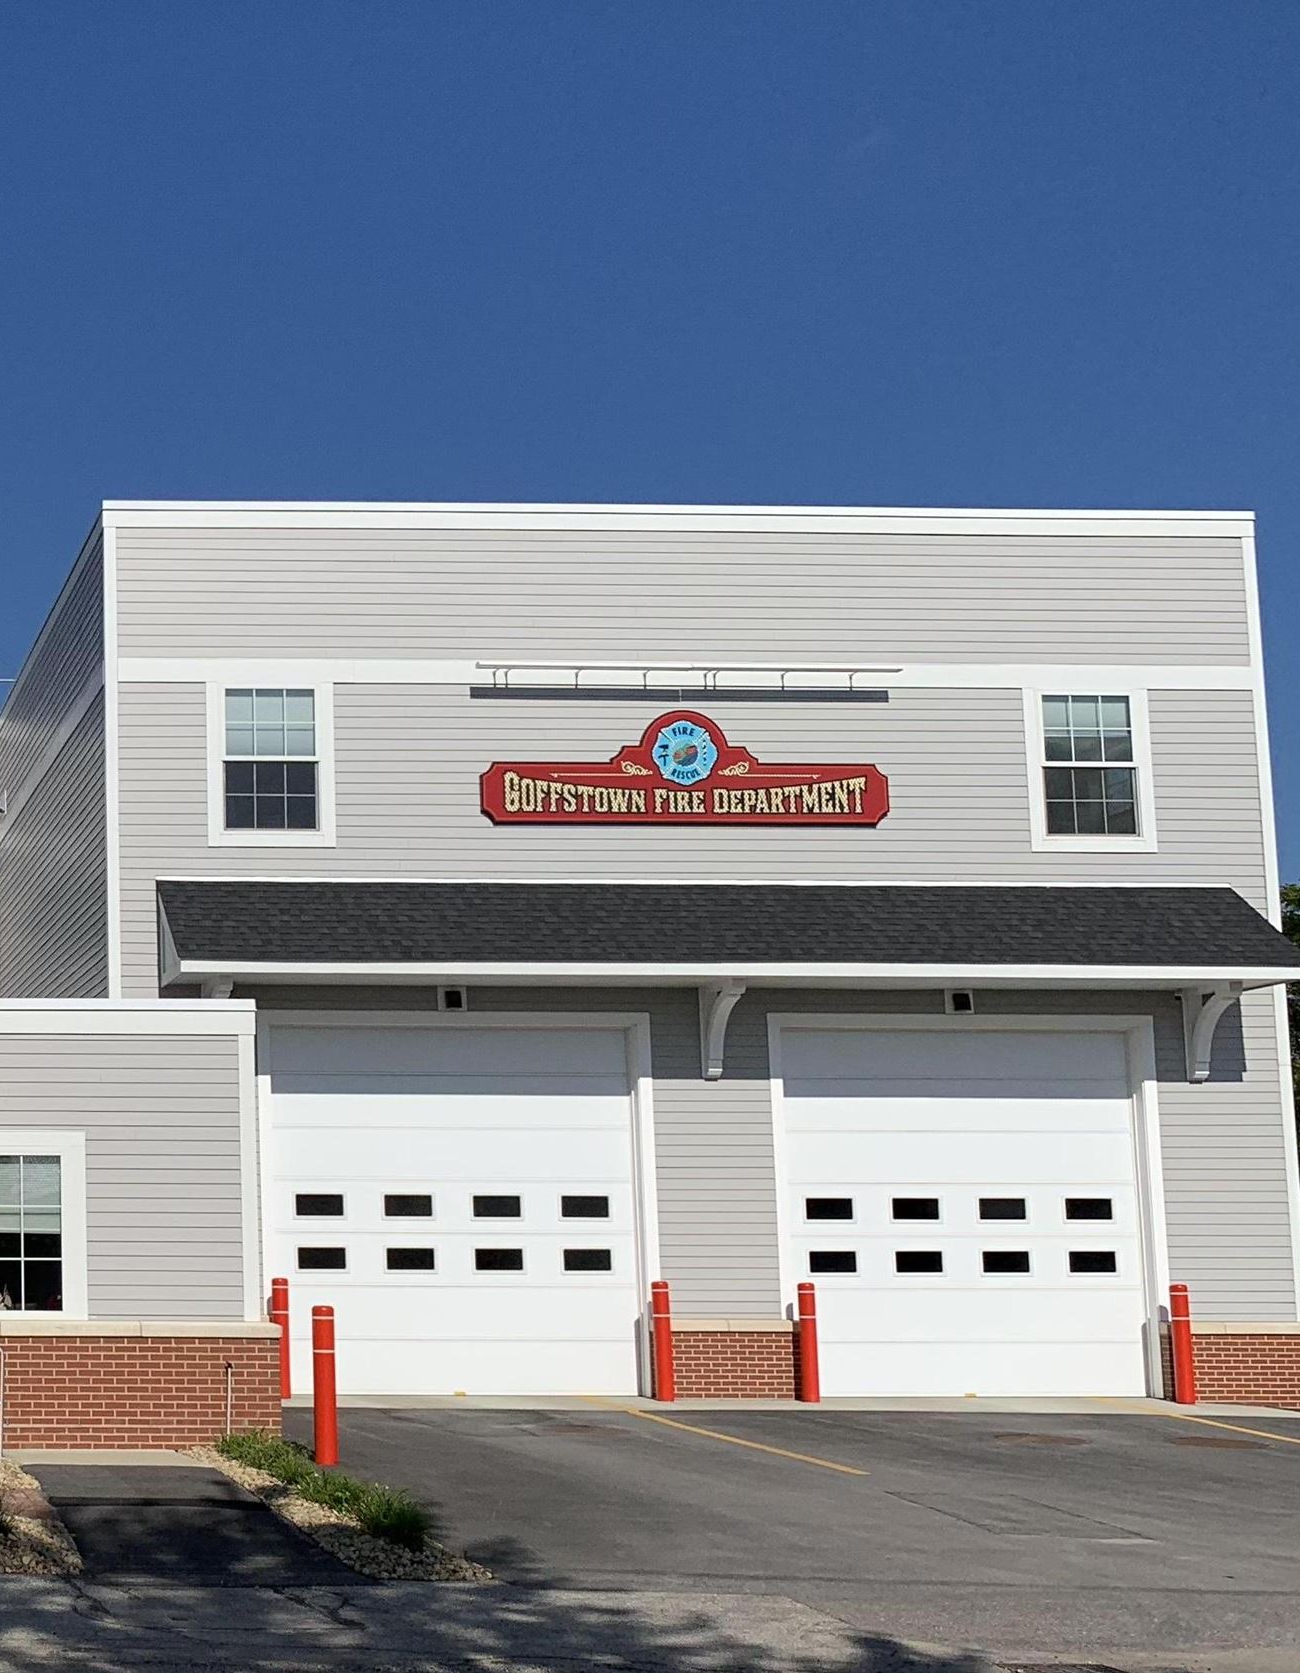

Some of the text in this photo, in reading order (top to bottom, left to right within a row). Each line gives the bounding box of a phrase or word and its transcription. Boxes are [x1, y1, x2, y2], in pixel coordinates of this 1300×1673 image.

[672, 726, 696, 737] FIRE
[671, 768, 700, 780] RESCUE
[503, 771, 866, 813] GOFFSTOWN FIRE DEPARTMENT
